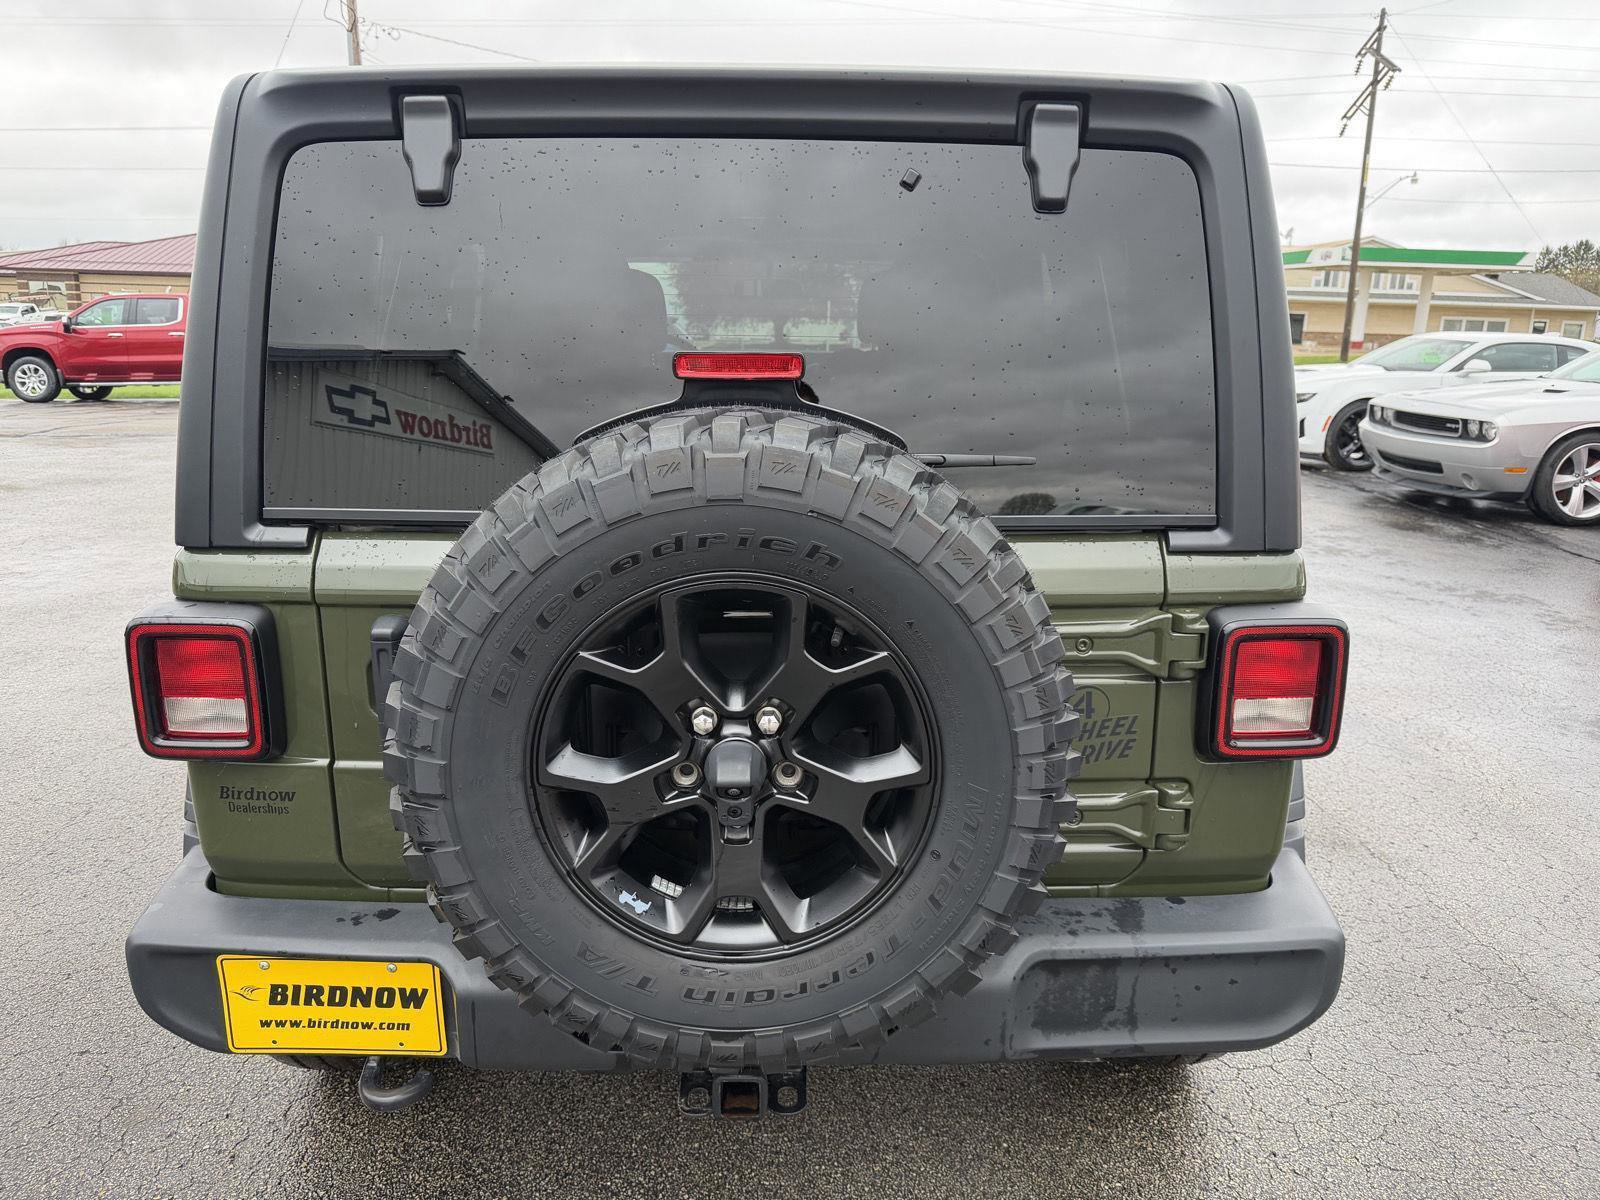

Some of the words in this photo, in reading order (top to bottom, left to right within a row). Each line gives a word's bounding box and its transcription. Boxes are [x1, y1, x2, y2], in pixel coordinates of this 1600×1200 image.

[489, 528, 844, 710] BFGoodrich
[1072, 690, 1096, 720] 4
[1078, 715, 1139, 742] HEEL
[1081, 738, 1137, 764] RIVE
[219, 785, 297, 801] Birdnow
[228, 801, 290, 815] Dealerships
[575, 941, 658, 998] T/A
[268, 983, 429, 1010] BIRDNOW
[259, 1017, 411, 1031] www.birdnow.com
